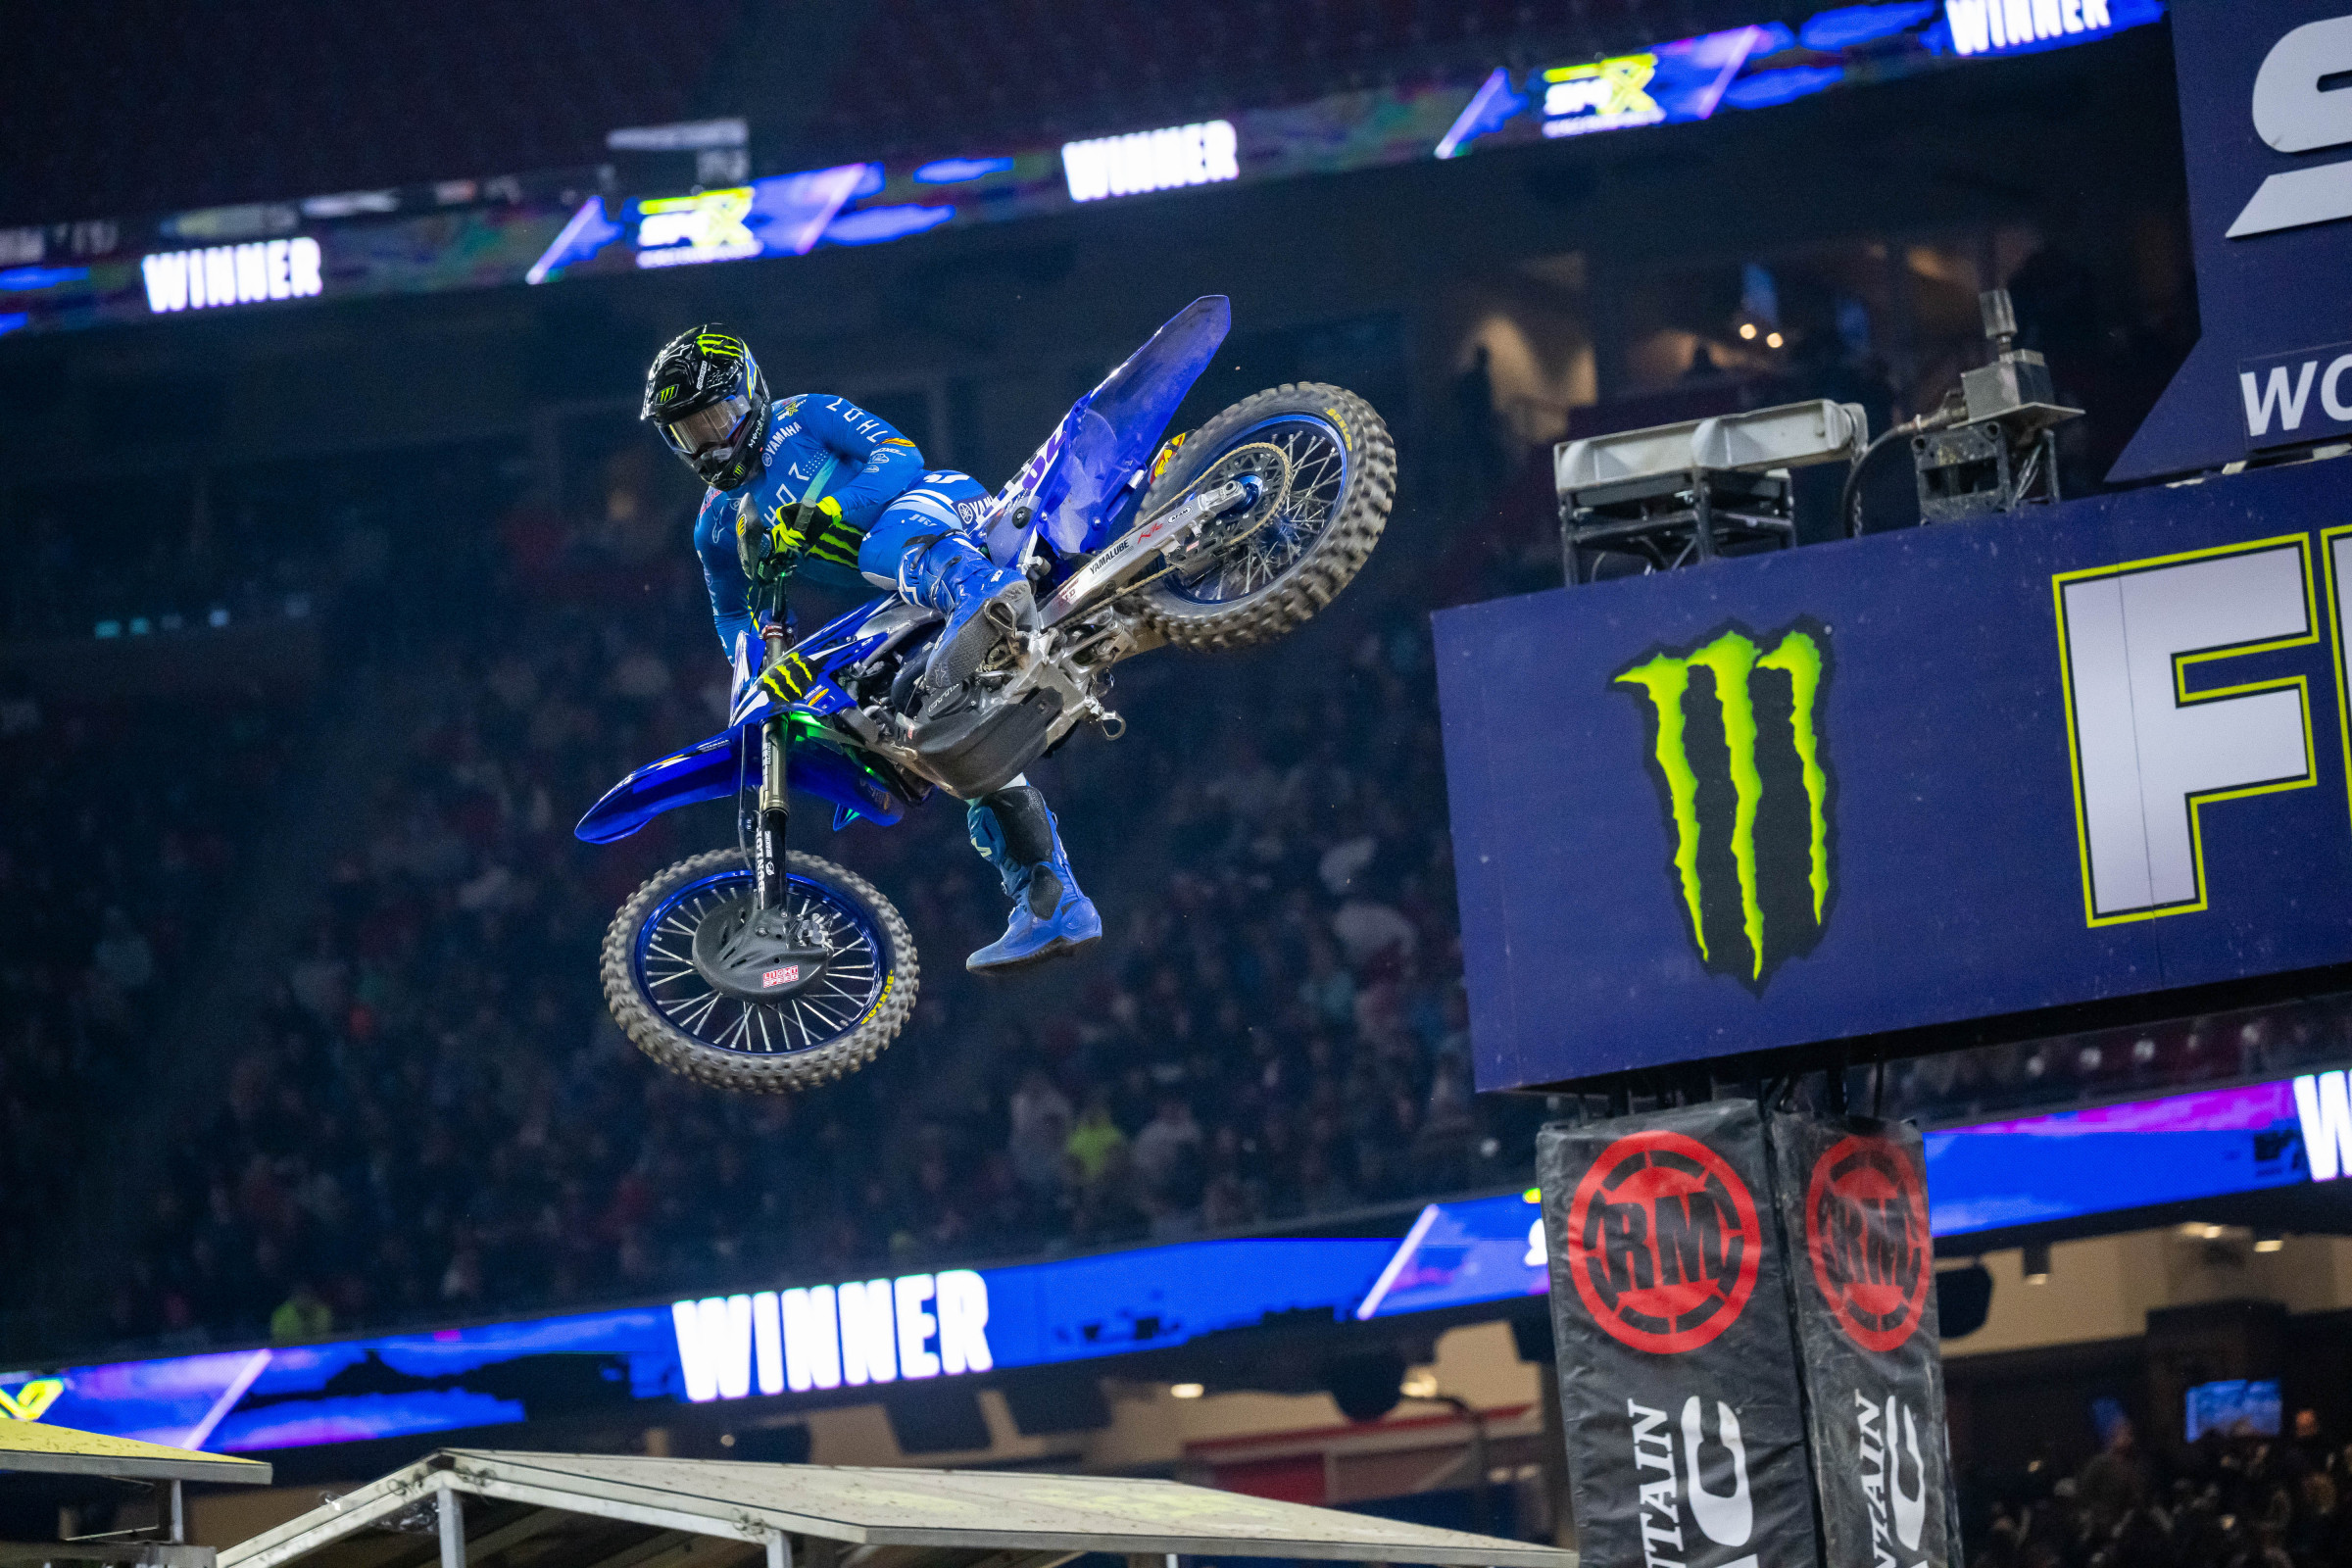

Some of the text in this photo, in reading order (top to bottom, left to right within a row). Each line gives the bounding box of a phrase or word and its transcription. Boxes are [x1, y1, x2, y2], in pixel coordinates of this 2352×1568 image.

[1061, 124, 1239, 203] WINNER
[141, 237, 321, 313] WINNER
[765, 421, 803, 455] YAMAHA
[1089, 540, 1130, 574] YAMALUBE
[2052, 524, 2352, 927] F
[861, 974, 895, 1025] DUNLOP
[1601, 1191, 1729, 1291] RM
[1835, 1197, 1907, 1286] RM
[672, 1269, 993, 1402] WINNER
